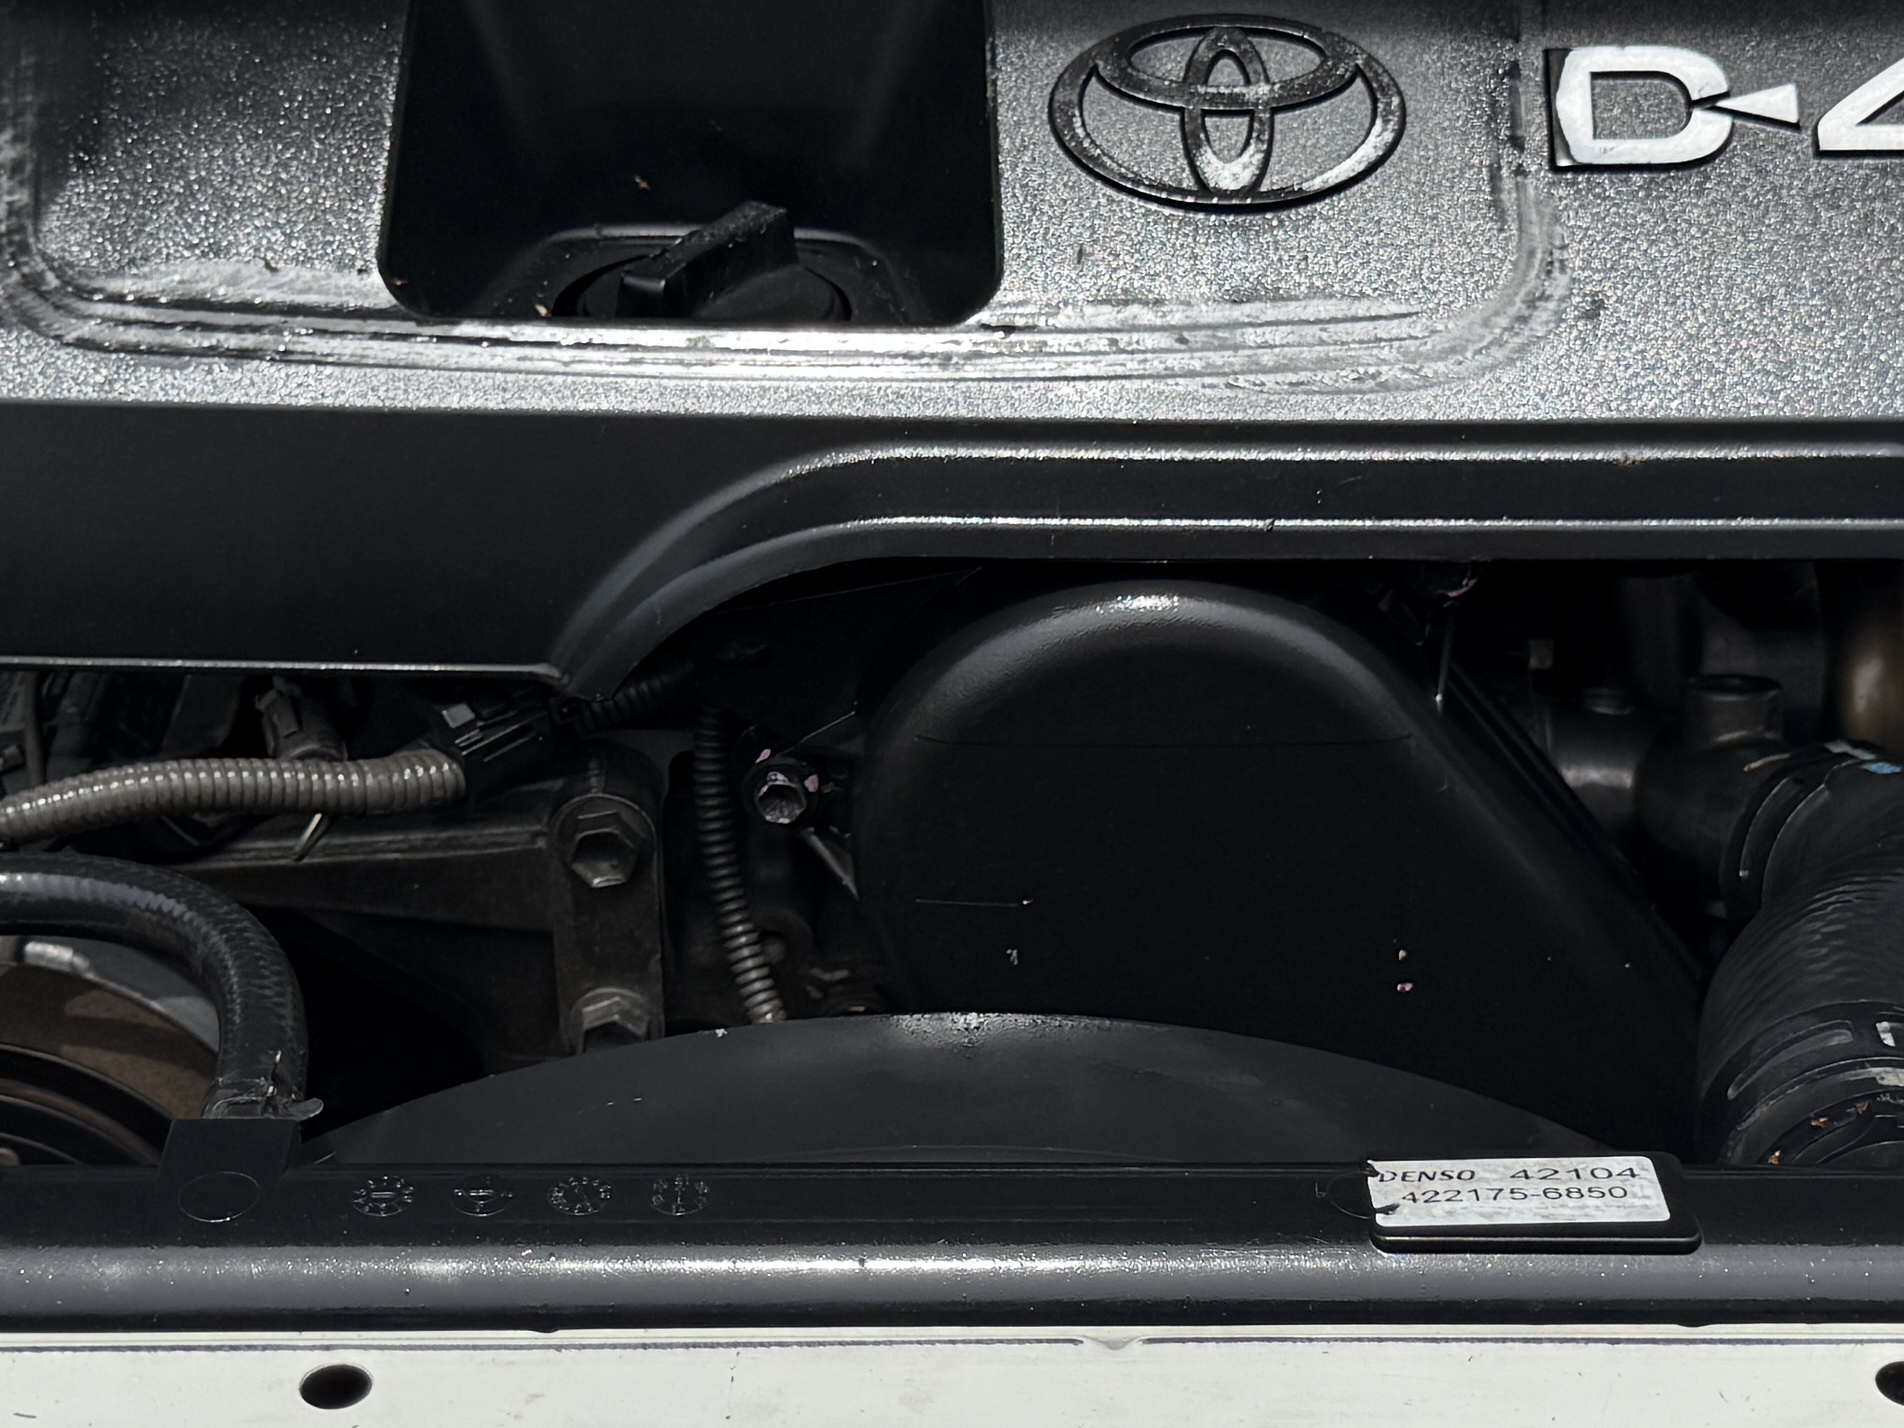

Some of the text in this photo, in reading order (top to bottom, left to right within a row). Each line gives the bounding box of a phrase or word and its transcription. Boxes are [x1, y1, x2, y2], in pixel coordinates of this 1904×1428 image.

[1378, 1167, 1641, 1183] DENSO 42104
[1401, 1186, 1629, 1205] 422175-6850
